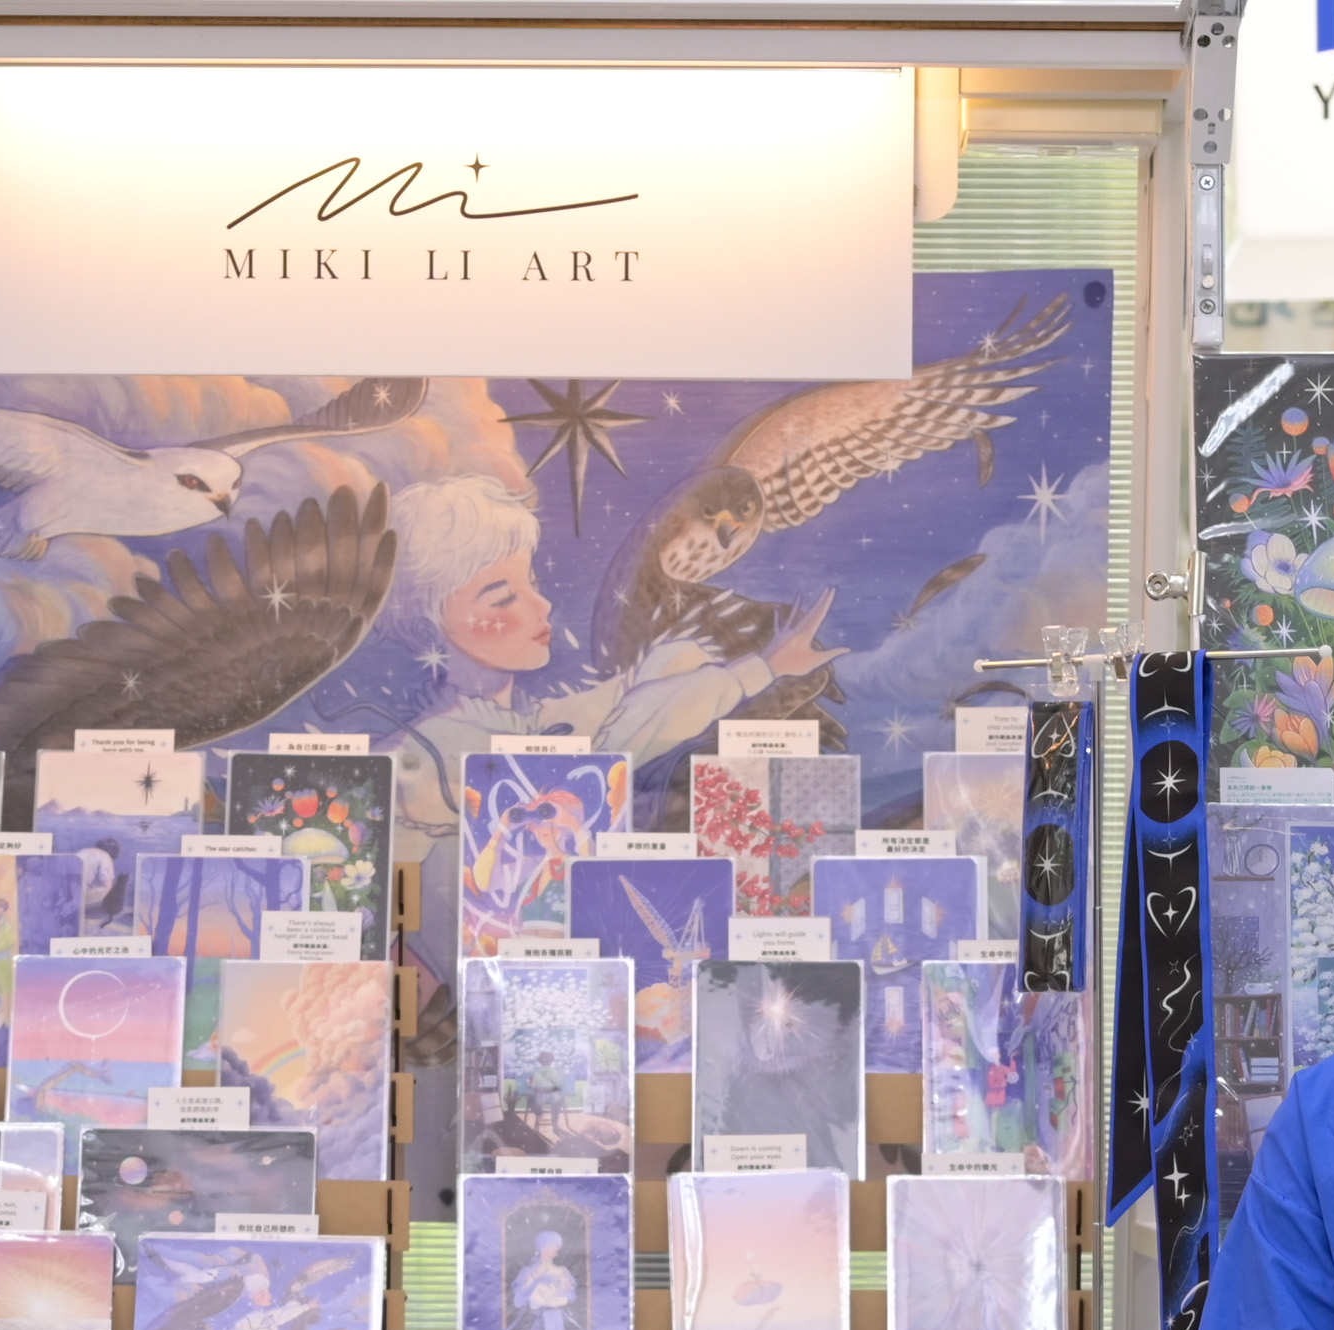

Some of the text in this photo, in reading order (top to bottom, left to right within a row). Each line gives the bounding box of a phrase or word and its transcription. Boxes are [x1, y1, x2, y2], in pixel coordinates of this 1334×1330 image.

[223, 248, 640, 282] MIKI LI ART
[627, 842, 666, 850] 夢想的重量
